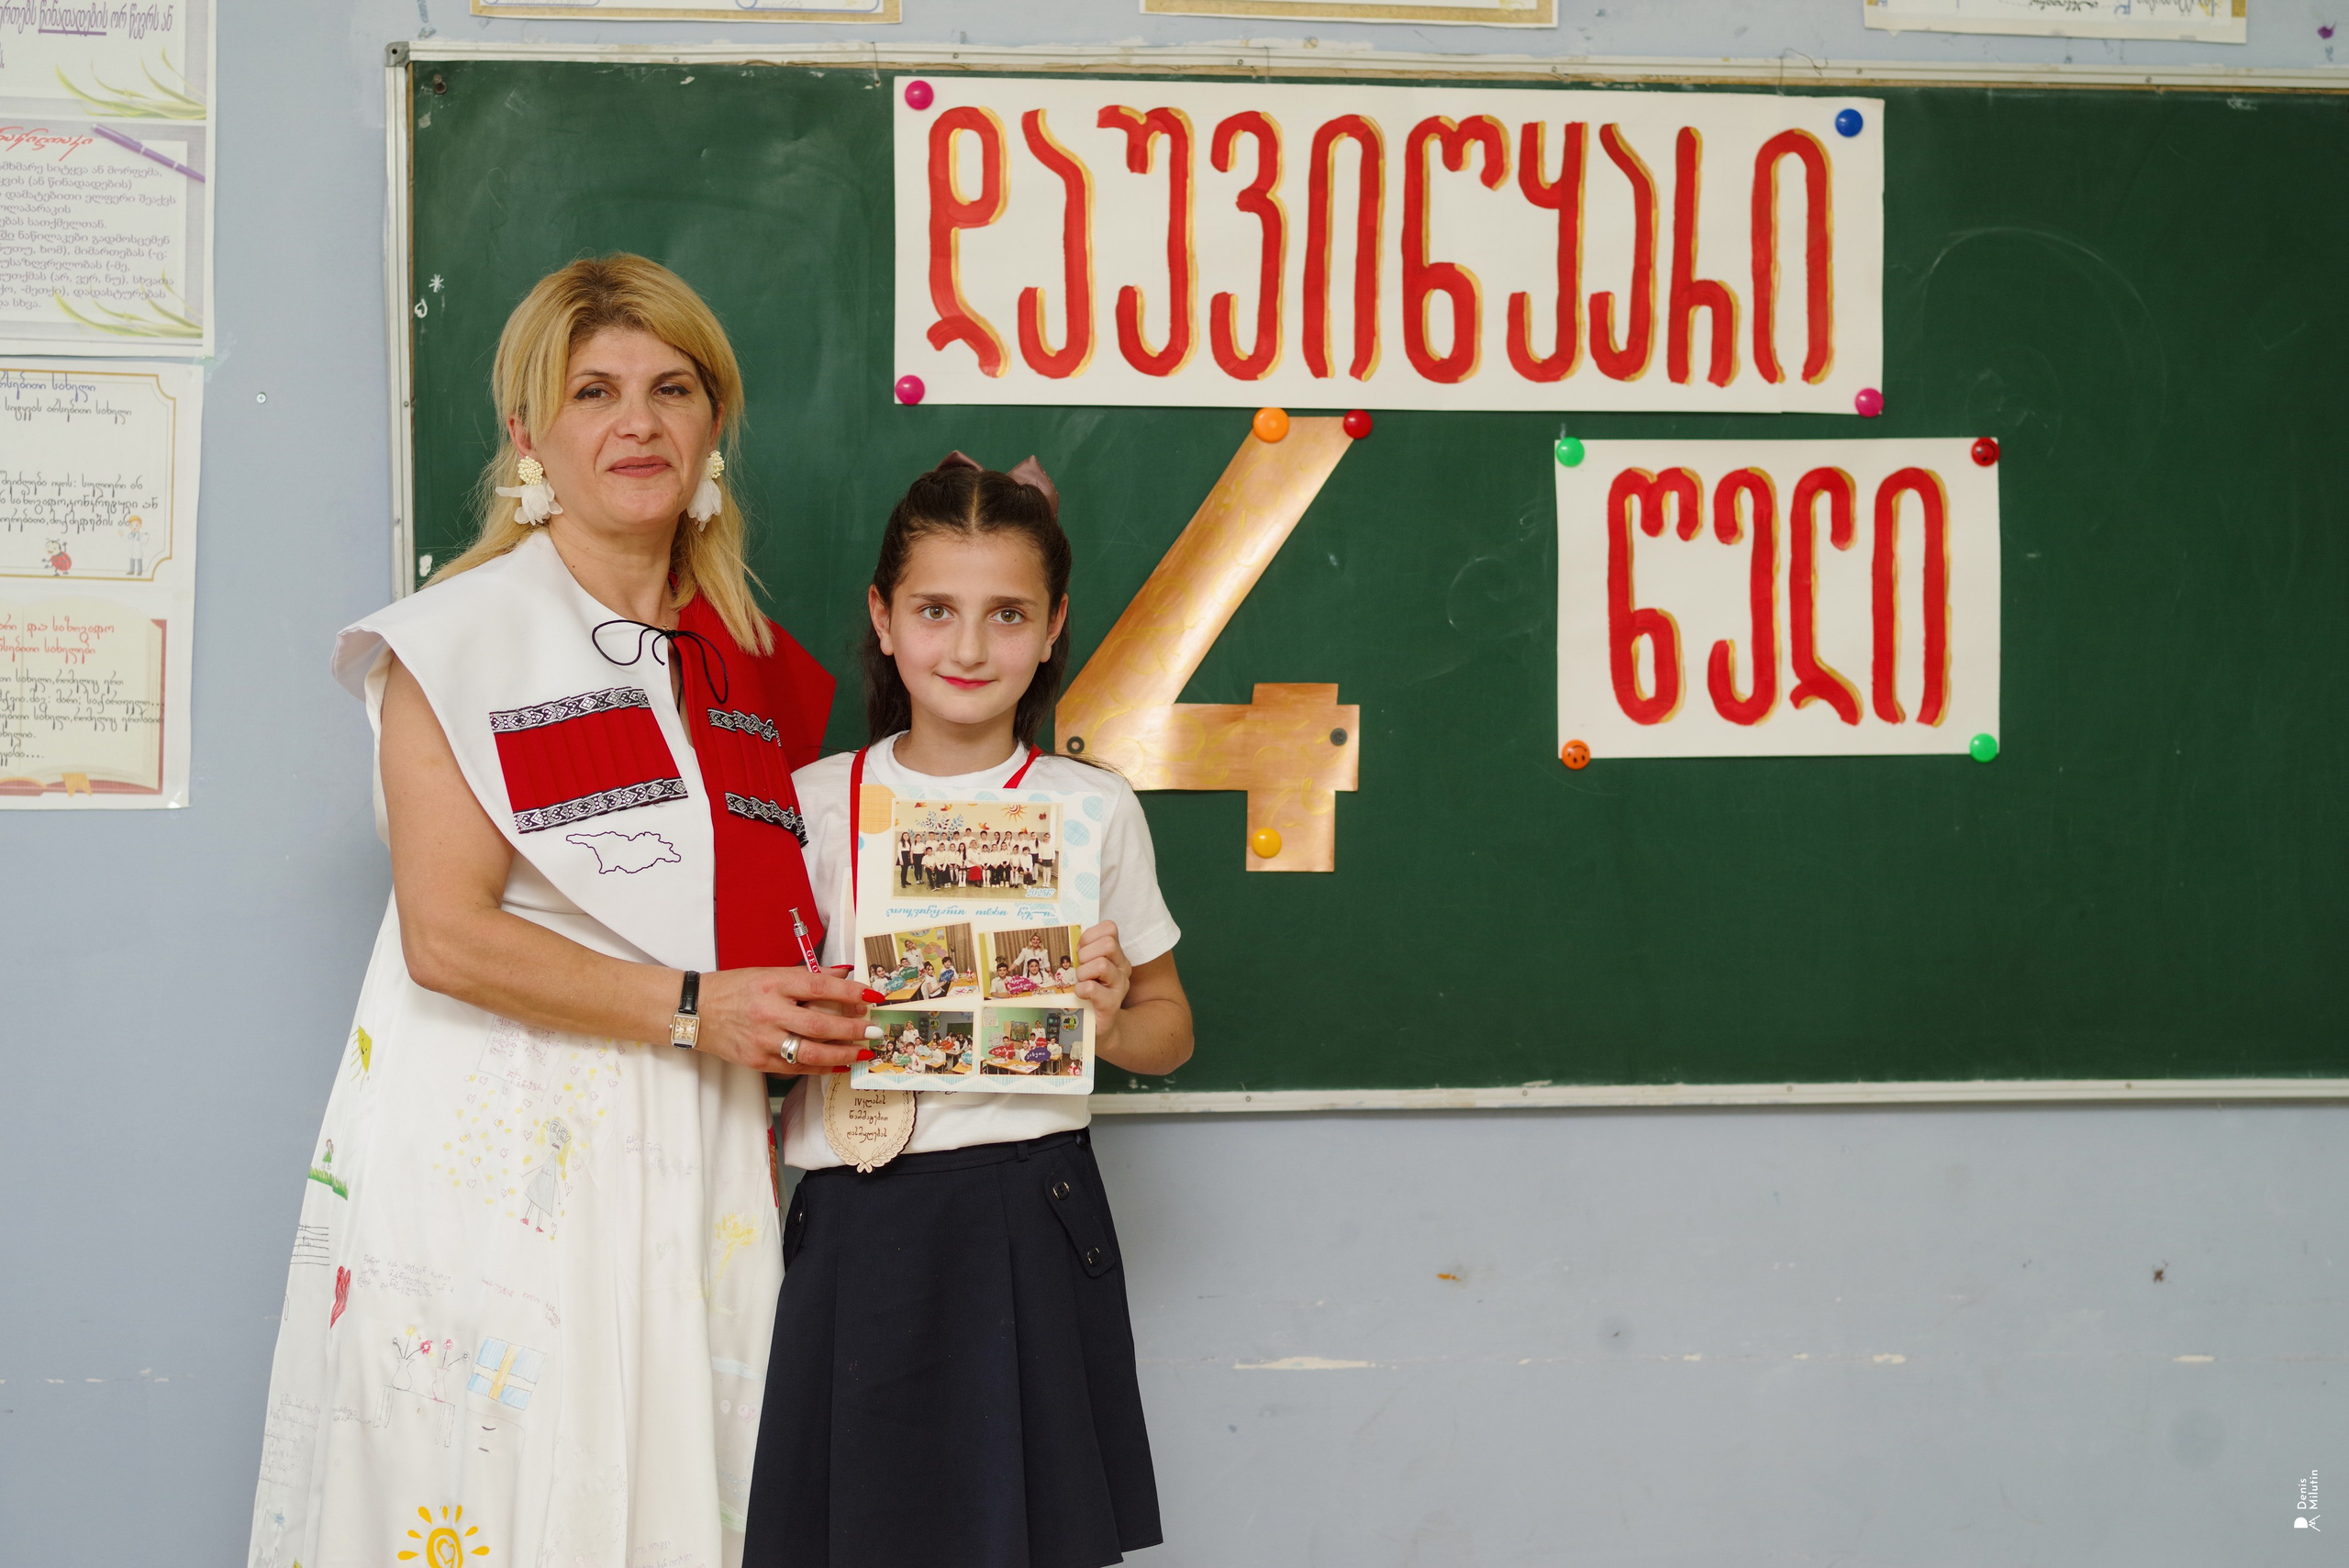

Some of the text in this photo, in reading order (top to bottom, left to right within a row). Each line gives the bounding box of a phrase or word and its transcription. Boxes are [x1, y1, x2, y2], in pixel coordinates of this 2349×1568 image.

[161, 5, 173, 31] ან
[92, 165, 104, 174] ან
[0, 243, 37, 256] უთუ,
[926, 105, 1833, 388] დაუვიწყარი
[0, 271, 47, 284] უთქმას
[1606, 465, 1952, 727] წელი
